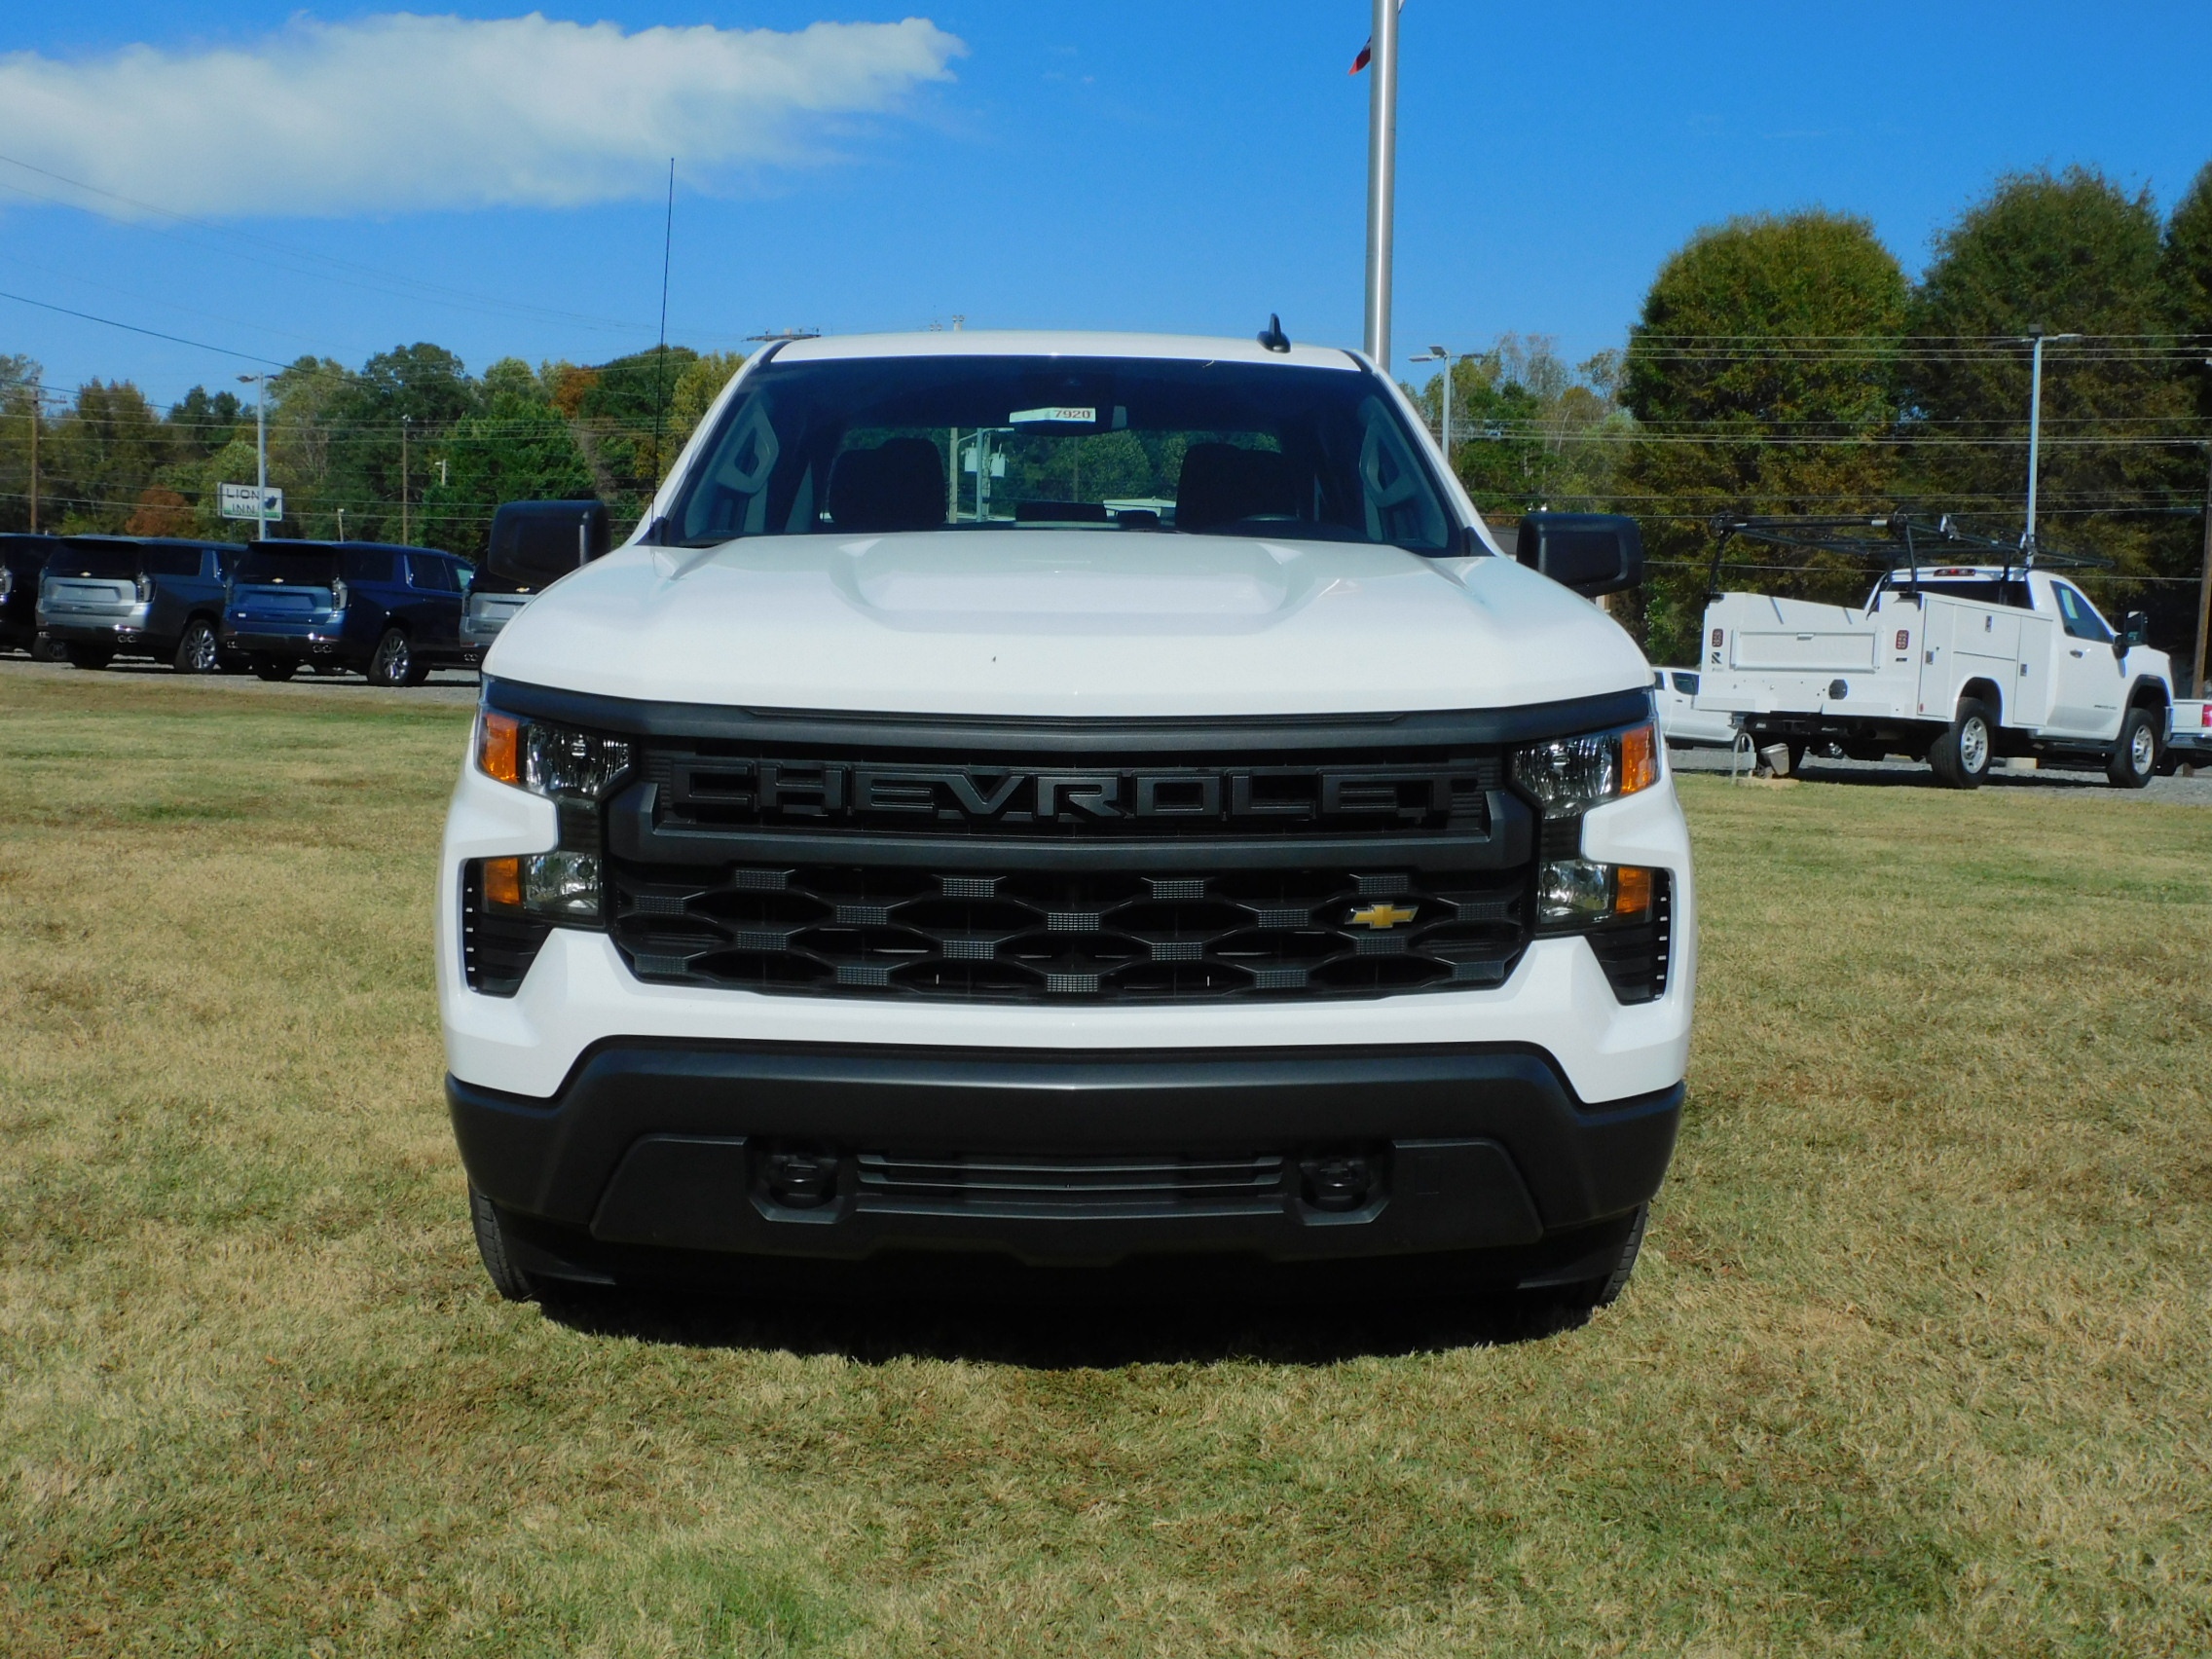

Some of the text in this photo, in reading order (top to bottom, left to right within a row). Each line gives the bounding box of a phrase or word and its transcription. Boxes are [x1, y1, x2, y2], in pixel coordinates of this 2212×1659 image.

[1054, 410, 1090, 419] 7920
[227, 488, 260, 499] LION
[672, 762, 1478, 817] CHEVROLET
